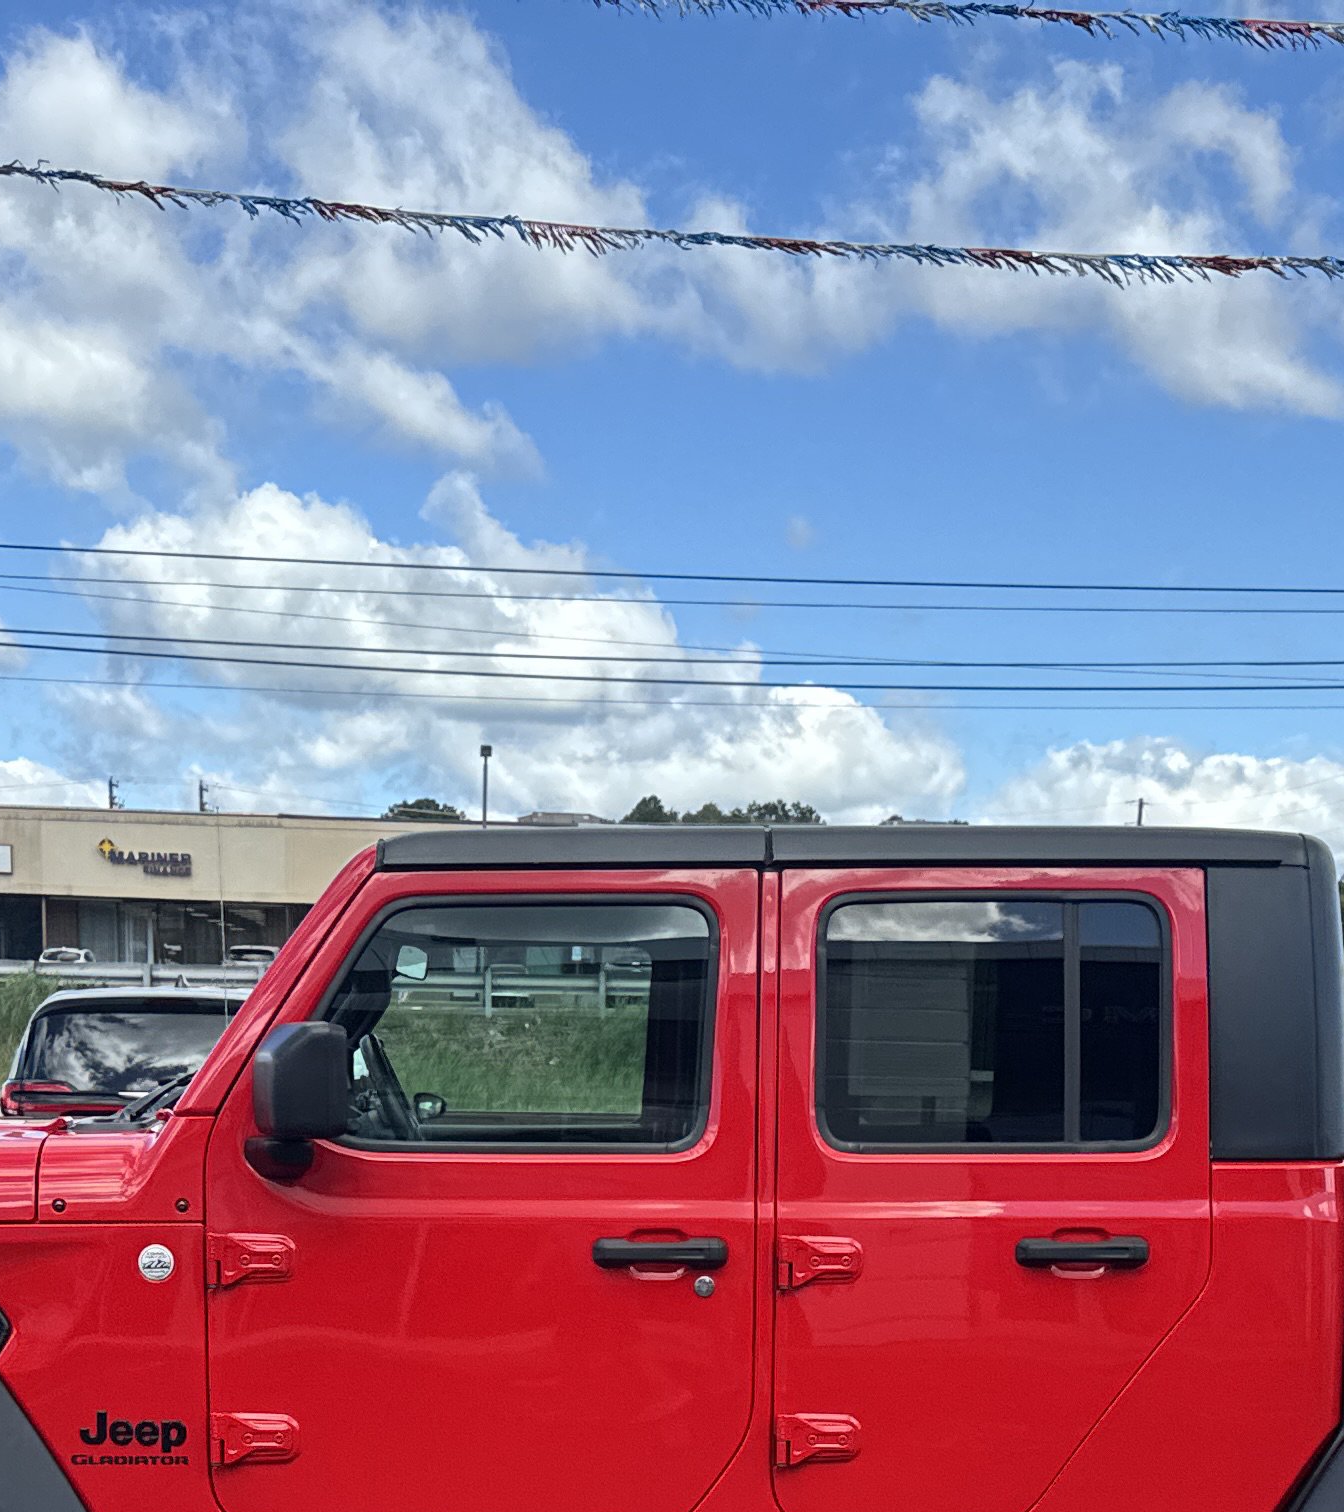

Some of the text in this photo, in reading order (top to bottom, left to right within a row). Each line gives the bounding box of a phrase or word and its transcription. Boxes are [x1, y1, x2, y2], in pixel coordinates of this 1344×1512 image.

[109, 850, 192, 866] MARINER
[79, 1409, 188, 1453] Jeep
[70, 1453, 190, 1465] GLADIATOR
